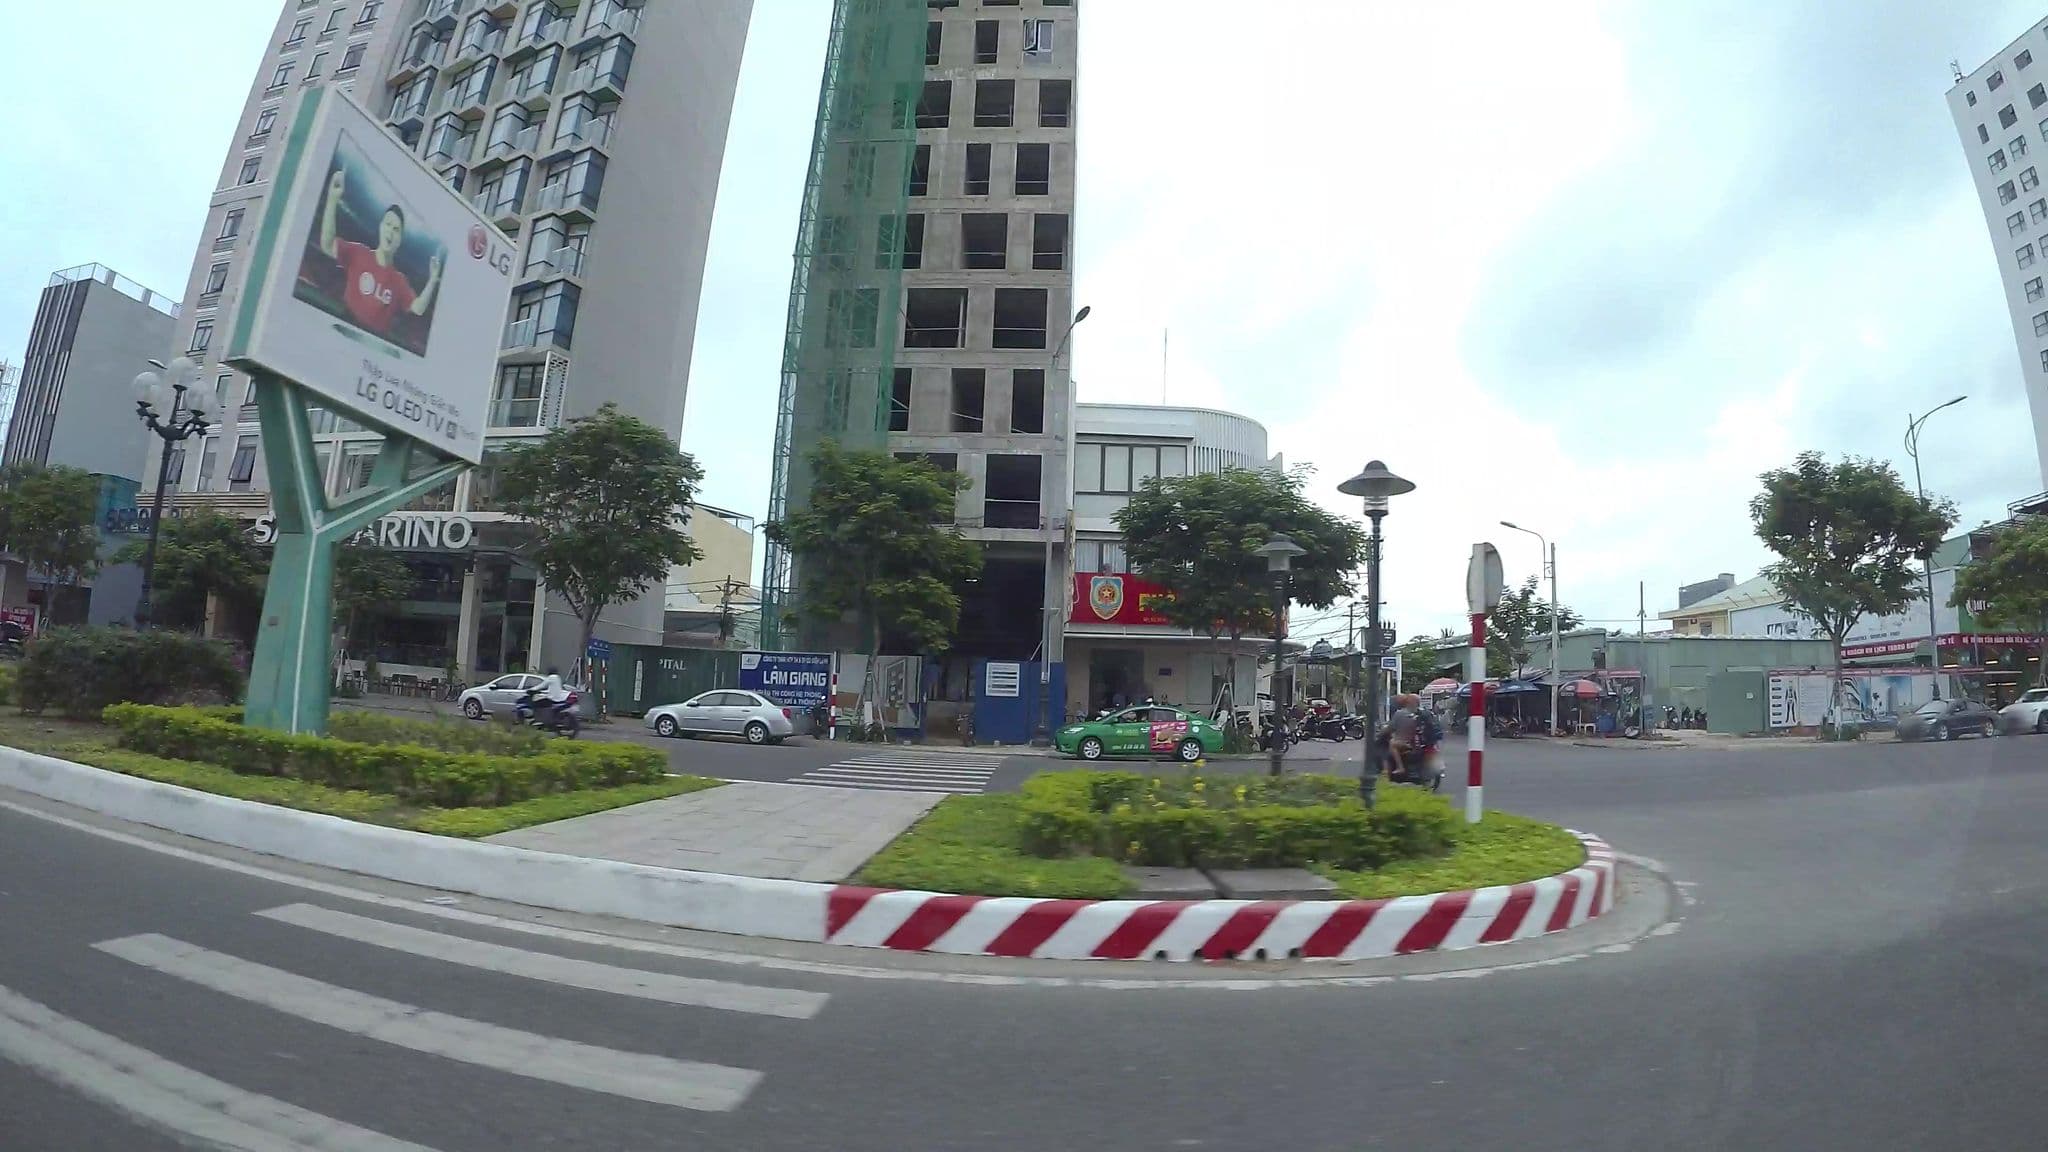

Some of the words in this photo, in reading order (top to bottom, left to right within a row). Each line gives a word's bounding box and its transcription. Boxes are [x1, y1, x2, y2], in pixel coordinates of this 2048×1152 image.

[488, 244, 511, 276] LG
[374, 283, 393, 305] LG
[356, 375, 379, 402] LG
[383, 390, 423, 422] OLED
[426, 409, 444, 433] TV
[763, 665, 788, 686] LÂM
[789, 671, 827, 687] GIANG
